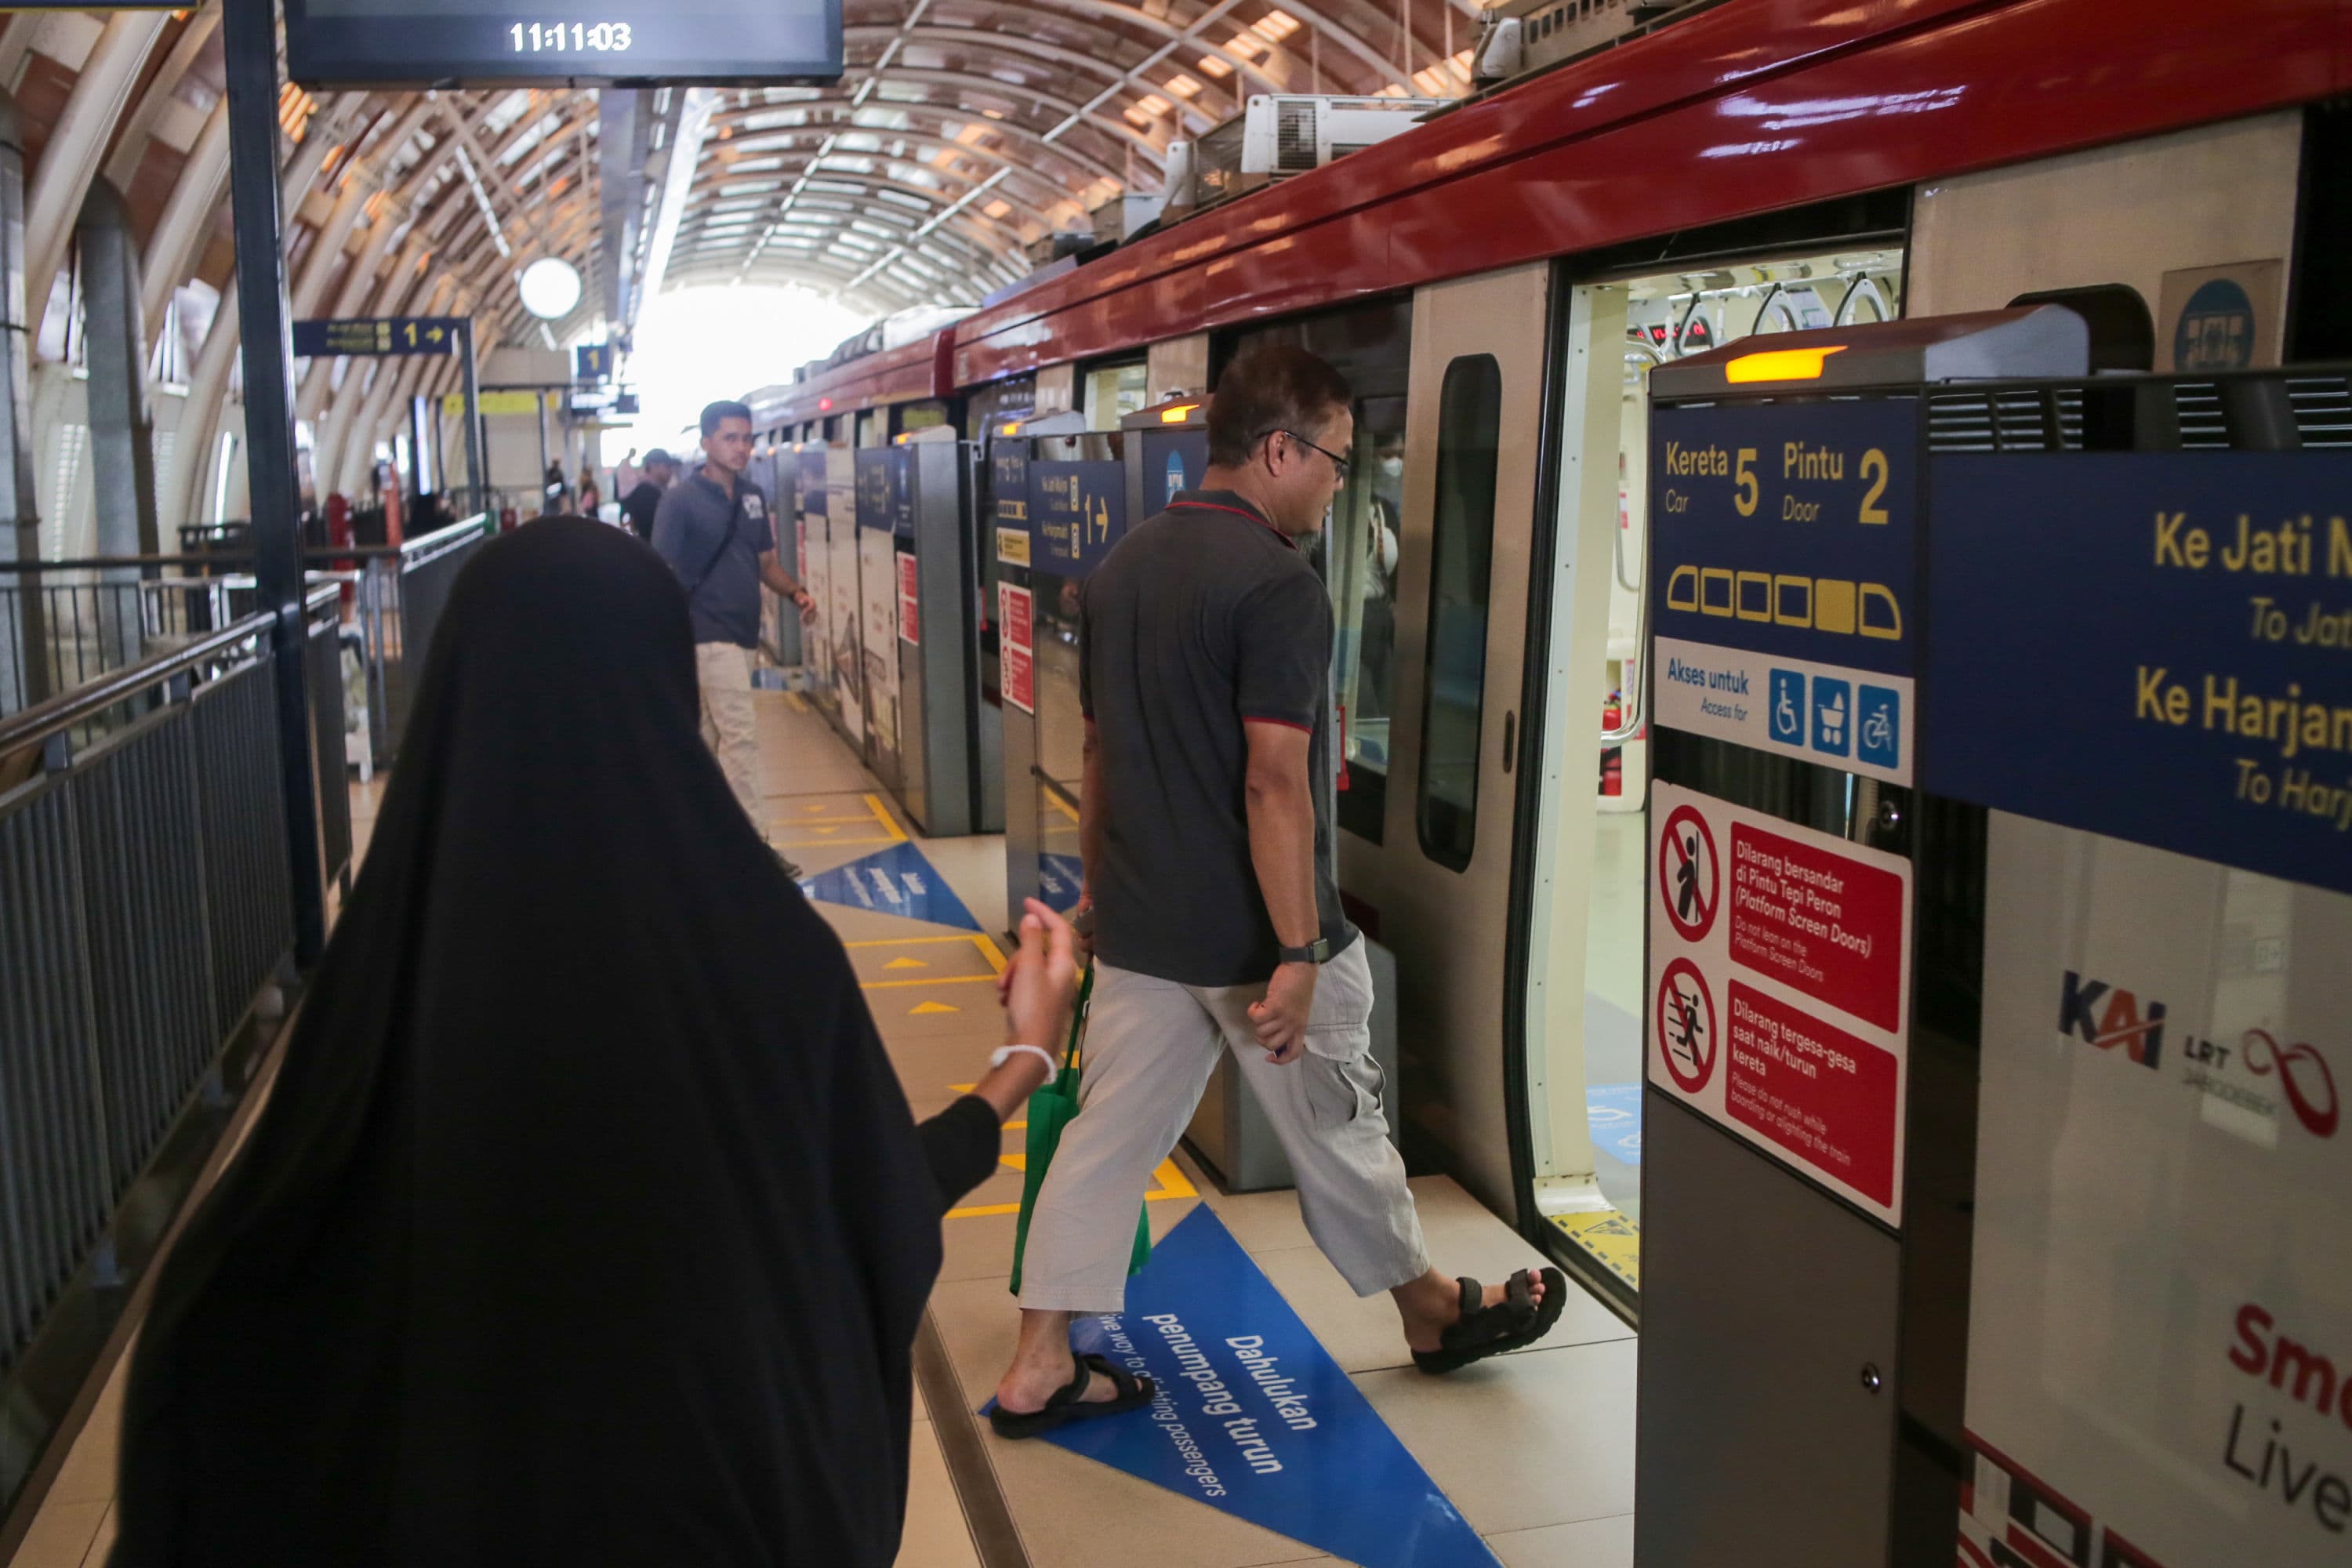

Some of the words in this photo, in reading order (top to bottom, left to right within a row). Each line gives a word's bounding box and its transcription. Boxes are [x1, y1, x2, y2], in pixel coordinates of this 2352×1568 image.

[510, 22, 632, 52] 11:11:03
[404, 322, 418, 347] 1
[1665, 488, 1690, 513] Car
[1667, 441, 1729, 476] Kereta
[1734, 448, 1759, 517] 5
[1784, 441, 1844, 480] Pintu
[1859, 448, 1889, 524] 2
[1782, 495, 1820, 521] Door
[2154, 511, 2211, 569] Ke
[2221, 514, 2312, 576] Jati
[2249, 596, 2288, 642] To
[1668, 657, 1706, 687] Akses
[1709, 669, 1749, 696] untuk
[2136, 664, 2191, 726] Ke
[1700, 696, 1732, 718] Access
[1733, 703, 1748, 721] for
[2234, 757, 2271, 804] To
[1736, 865, 1747, 882] di
[1749, 867, 1777, 895] Pintu
[1780, 879, 1804, 906] Tepi
[1806, 888, 1842, 919] Peron
[1737, 840, 1781, 877] Dilarang
[1784, 855, 1844, 894] bersandar
[1735, 885, 1786, 923] (Platform
[1788, 907, 1828, 939] Screen
[1831, 923, 1872, 960] Doors)
[1733, 997, 1778, 1040] Dilarang
[1780, 1022, 1857, 1075] tergesa-gesa
[2058, 969, 2167, 1071] KAI
[1733, 1025, 1755, 1047] saat
[1757, 1037, 1817, 1080] naik/turun
[1733, 1044, 1766, 1077] kereta
[2183, 1034, 2231, 1070] LRT
[1098, 1313, 1123, 1331] ive
[1108, 1332, 1138, 1355] way
[1124, 1356, 1147, 1369] to
[1225, 1334, 1318, 1431] Dahulukan
[1142, 1312, 1243, 1416] penumpang
[1223, 1417, 1283, 1475] turun
[1157, 1424, 1228, 1497] passengers
